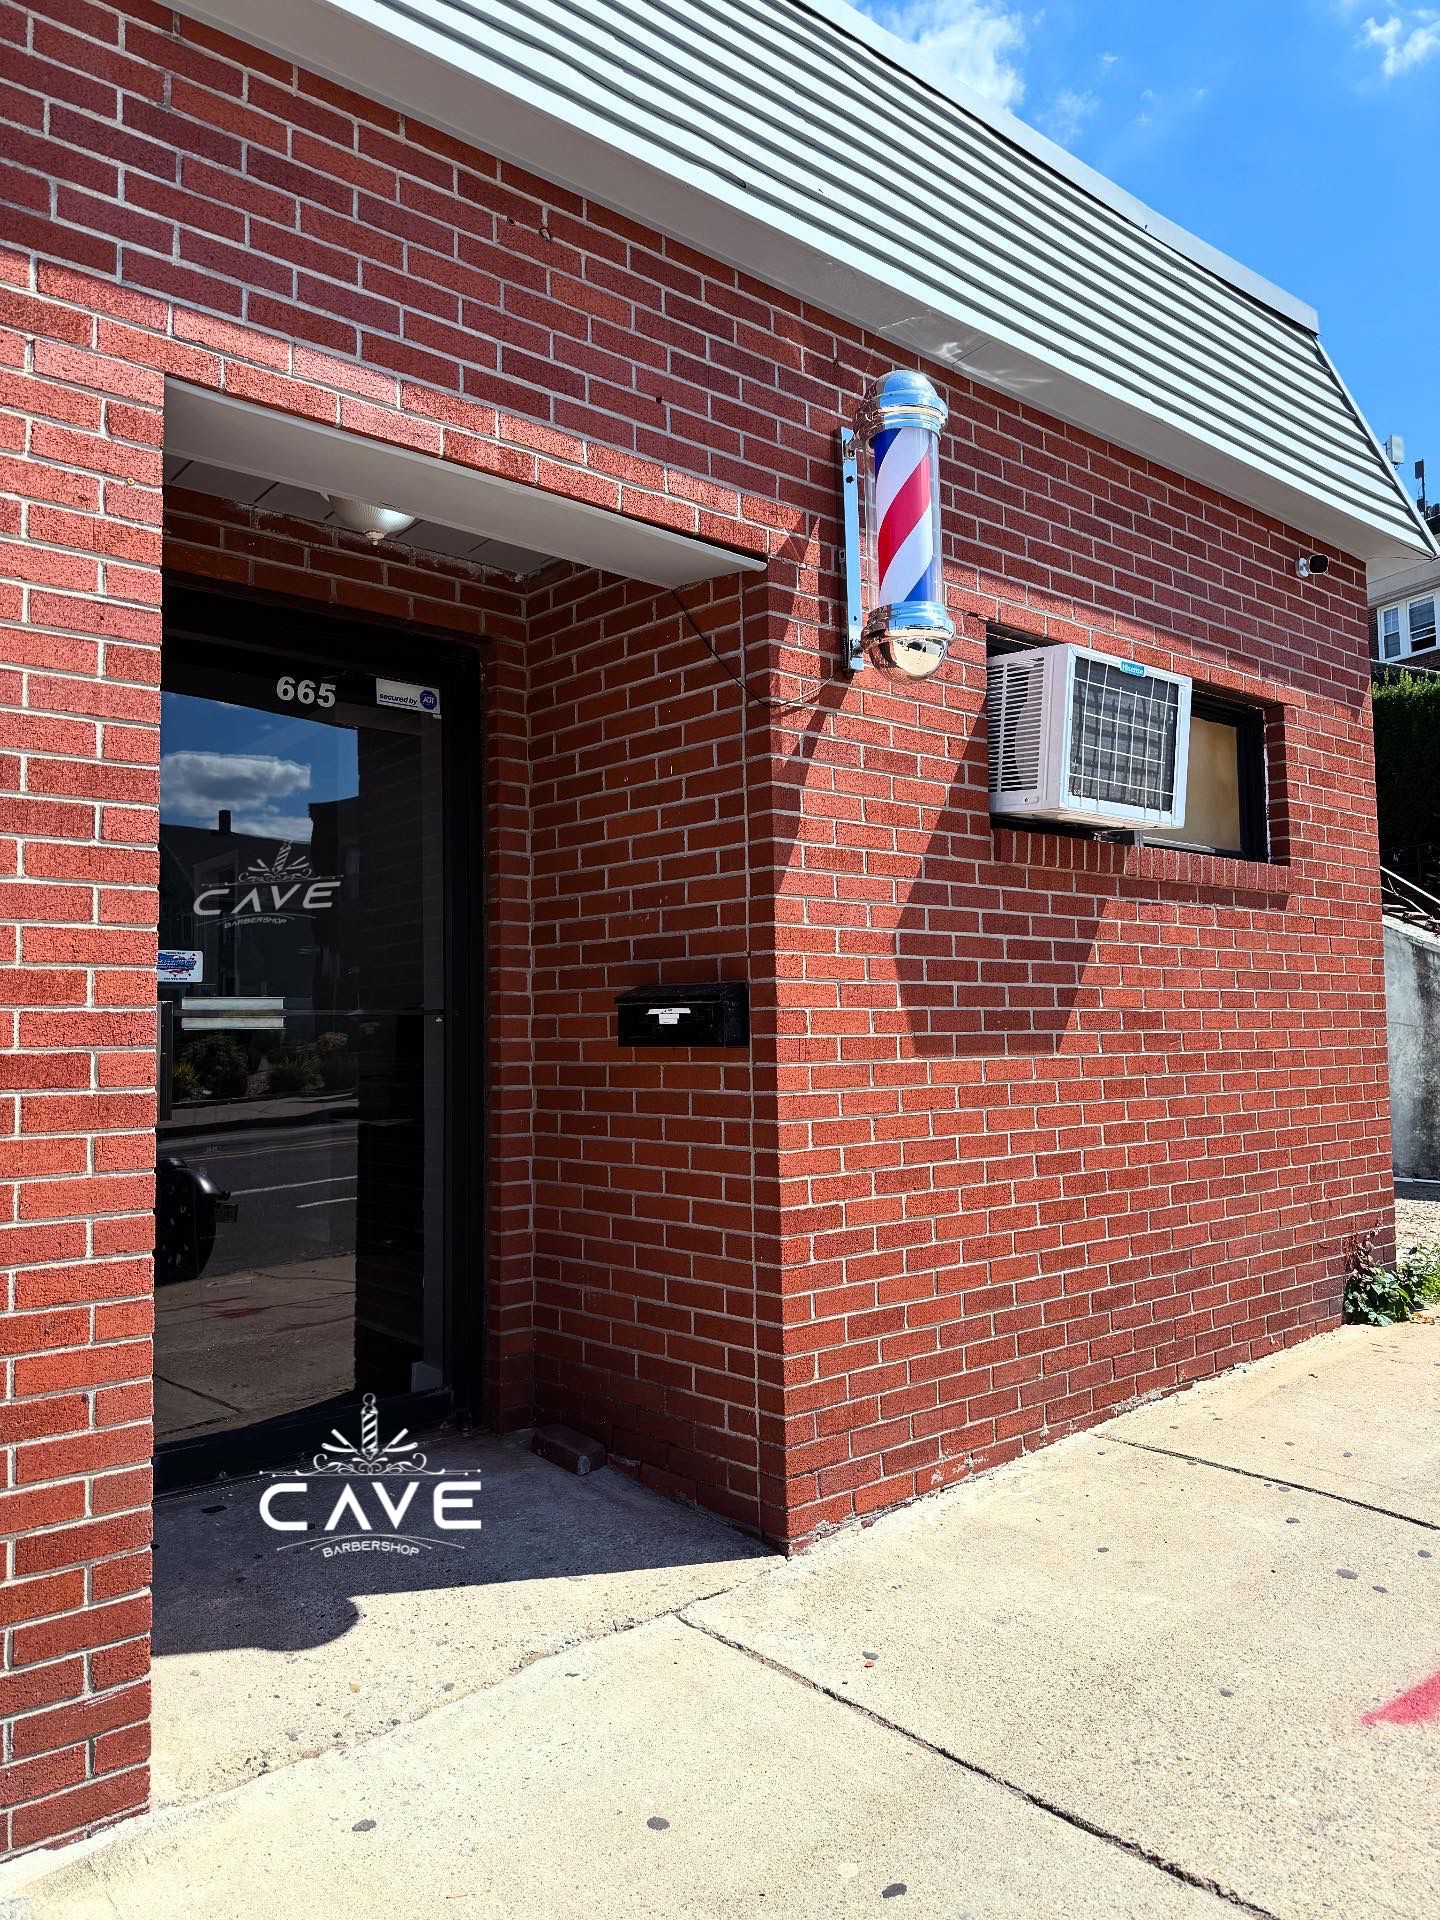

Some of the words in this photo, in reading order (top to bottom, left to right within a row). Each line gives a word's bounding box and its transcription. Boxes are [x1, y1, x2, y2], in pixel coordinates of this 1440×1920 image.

[1122, 663, 1144, 675] Hisense
[276, 676, 336, 708] 665
[379, 693, 408, 704] secured
[409, 697, 418, 706] by
[423, 696, 435, 705] ADT
[193, 881, 341, 916] CAVE
[224, 916, 287, 929] BARBERSHOP
